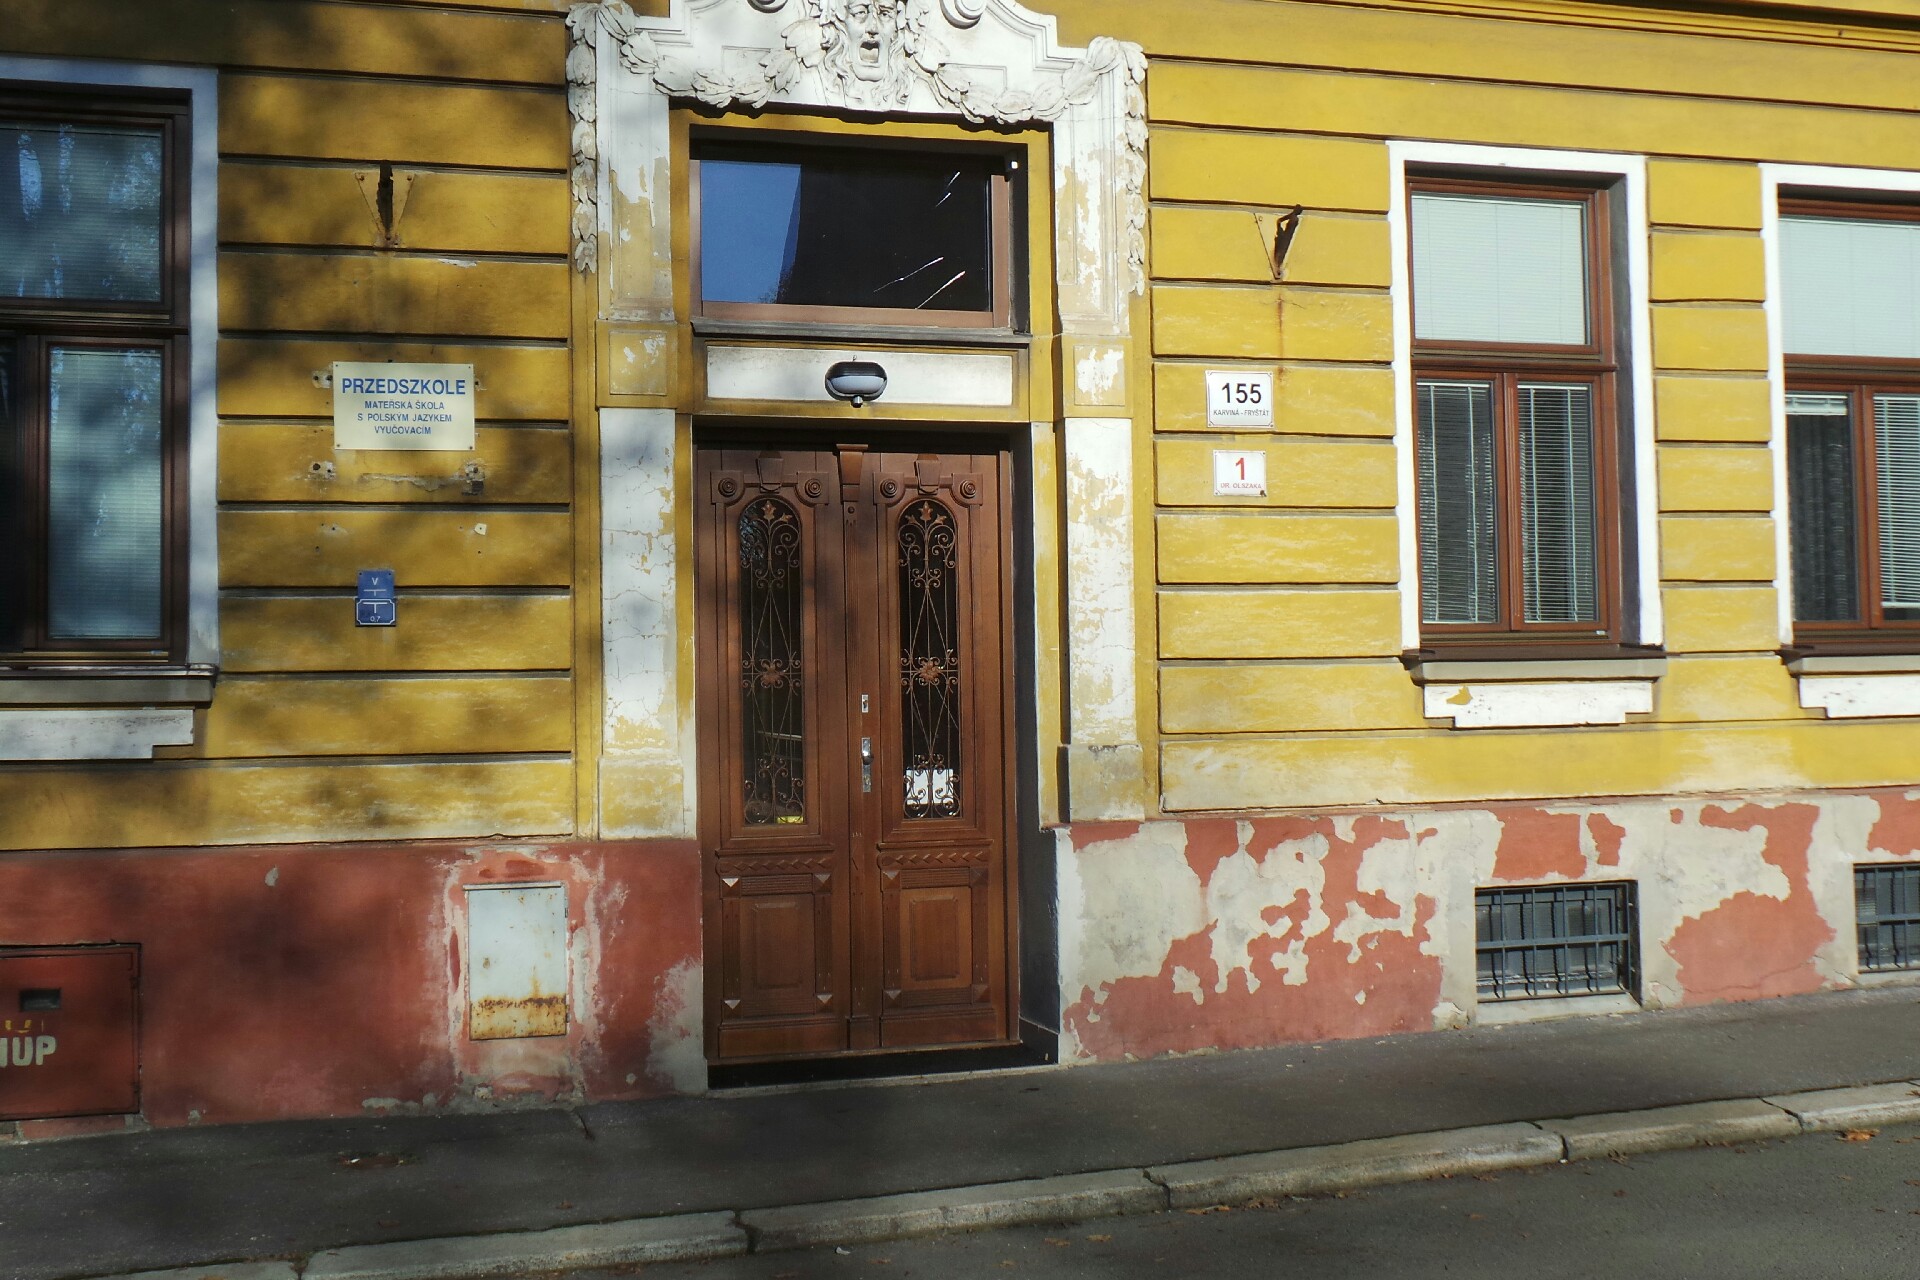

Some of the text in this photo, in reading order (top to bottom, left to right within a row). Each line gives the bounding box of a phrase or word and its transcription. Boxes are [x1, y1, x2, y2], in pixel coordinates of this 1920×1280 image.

[341, 377, 466, 395] PRZEDSZKOLE
[1221, 382, 1262, 404] 155
[364, 399, 445, 410] MATEŘSKÁ ŠKOLA
[357, 411, 452, 422] S POLSKÝM JAZYKEM
[1213, 408, 1240, 416] KARVINÁ
[374, 424, 432, 435] VYUČOVACÍM
[1235, 457, 1245, 480] 1
[371, 577, 379, 586] V
